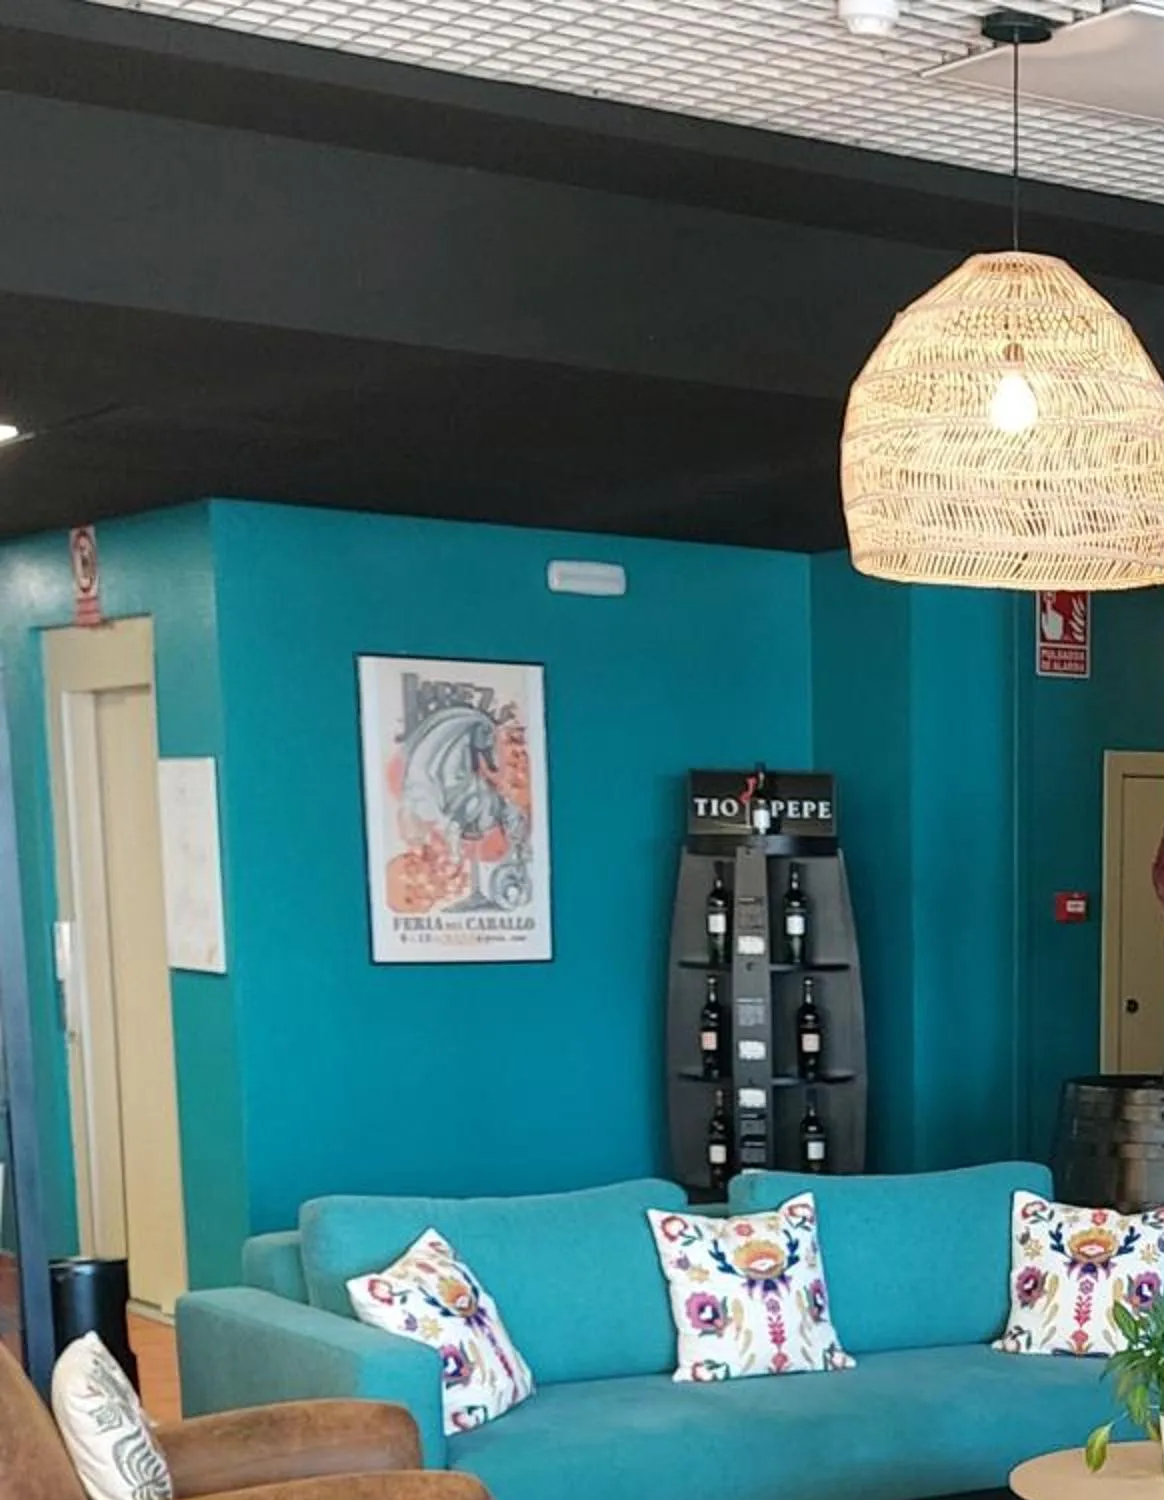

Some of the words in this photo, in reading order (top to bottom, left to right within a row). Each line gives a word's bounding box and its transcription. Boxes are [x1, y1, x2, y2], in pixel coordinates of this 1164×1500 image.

[693, 797, 739, 817] TIO
[770, 799, 833, 820] PEPE
[393, 917, 443, 931] FERIA
[465, 916, 536, 931] CABALLO
